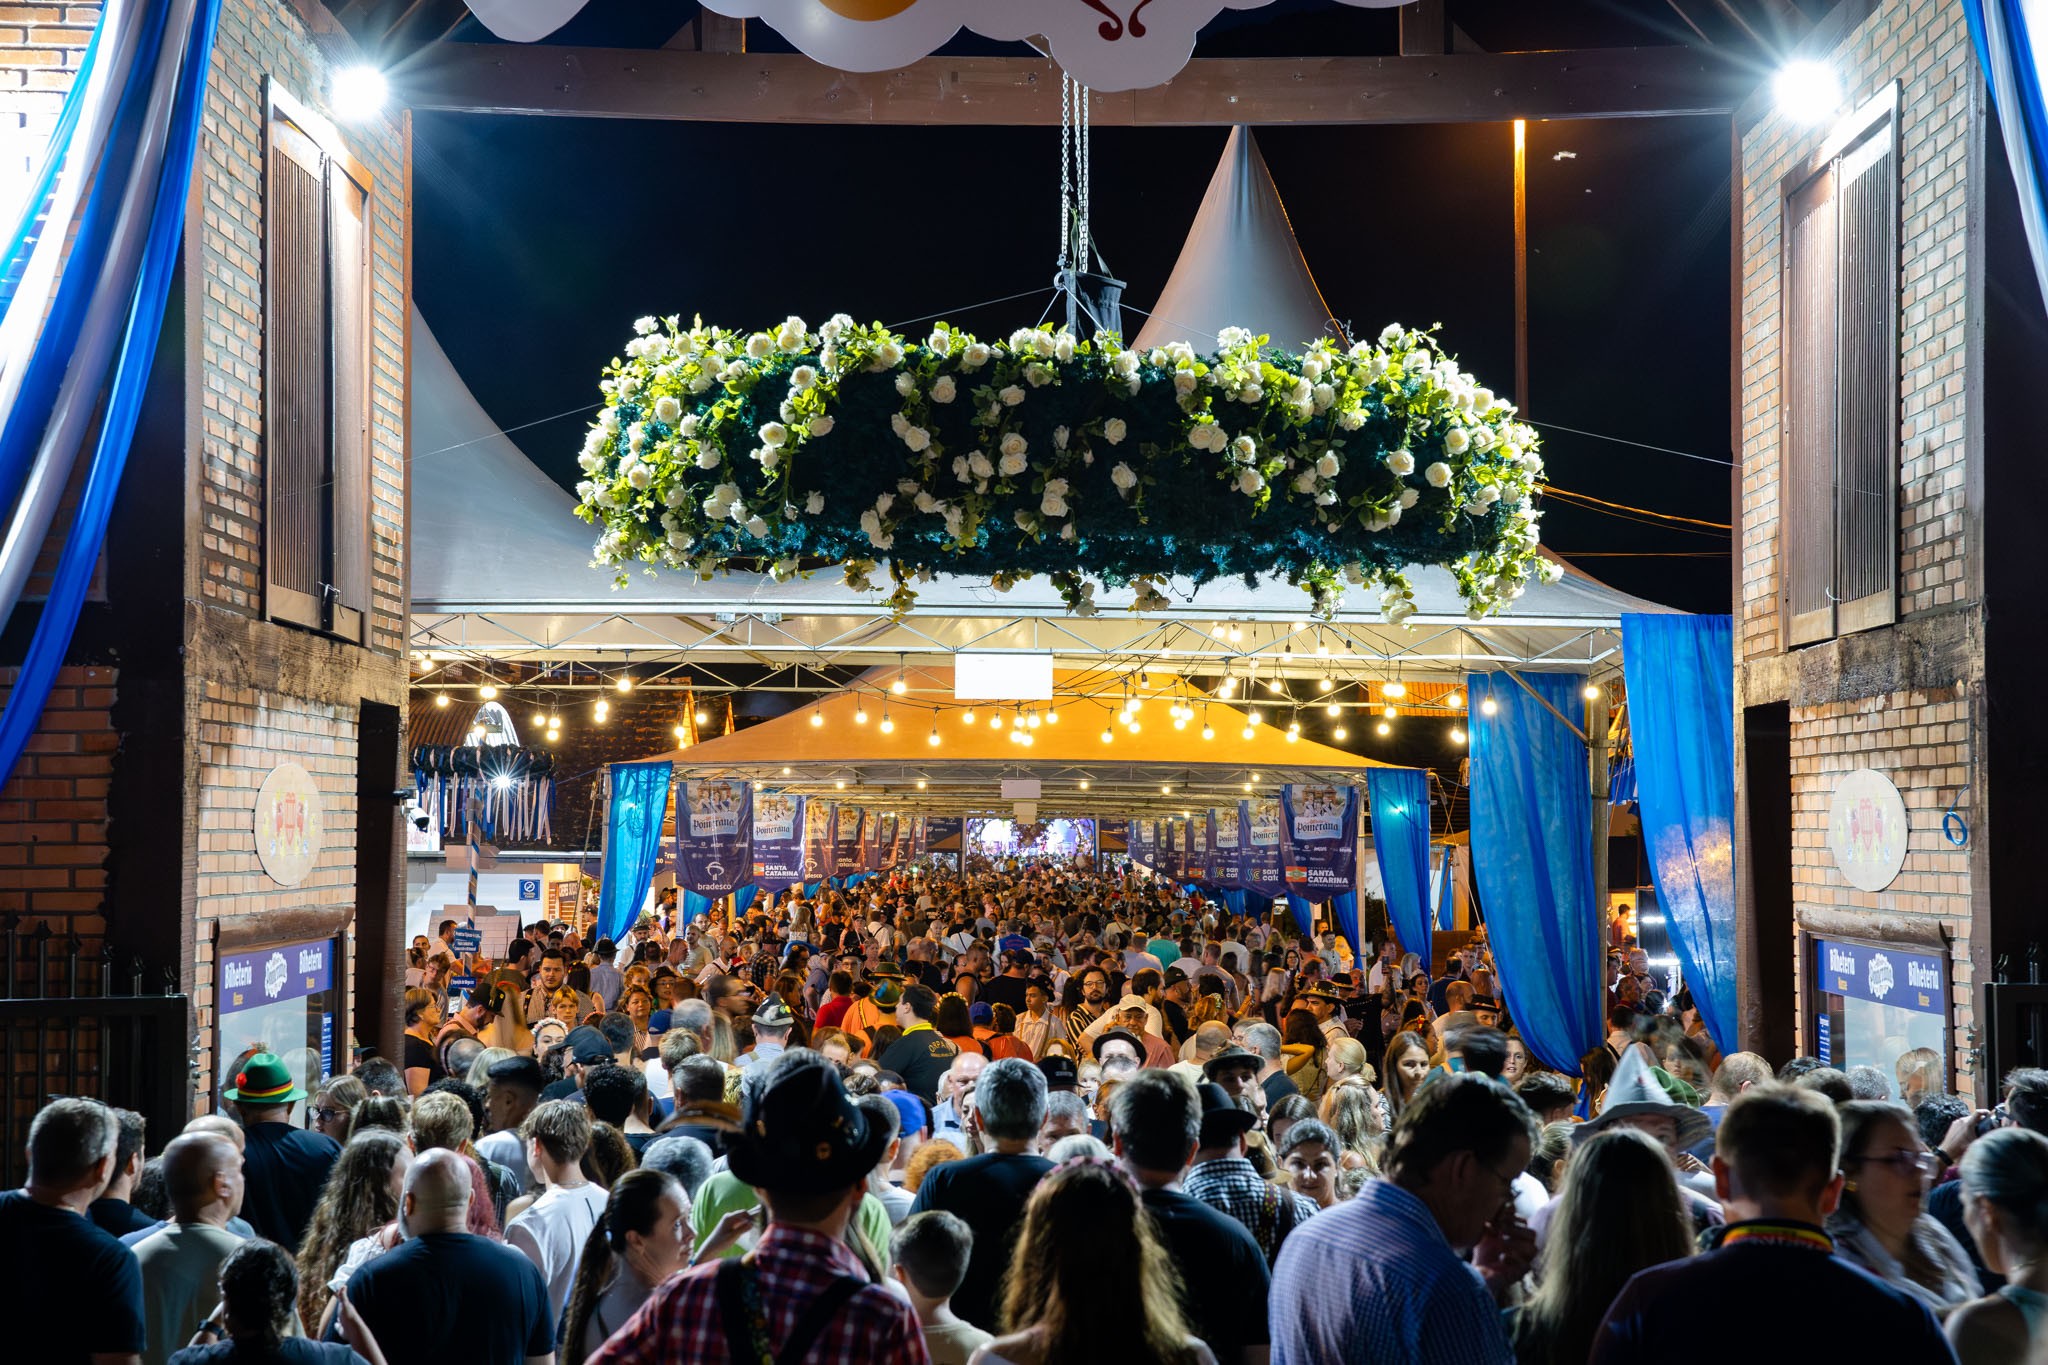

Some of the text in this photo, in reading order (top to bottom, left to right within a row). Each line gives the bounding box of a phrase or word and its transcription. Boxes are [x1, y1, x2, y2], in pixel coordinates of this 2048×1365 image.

[697, 882, 732, 890] bradesco
[1308, 876, 1349, 884] CATARINA
[299, 947, 322, 974] Bilheteria
[1829, 948, 1855, 975] Bilheteria
[224, 960, 252, 989] Bilheteria
[1908, 961, 1939, 990] Bilheteria
